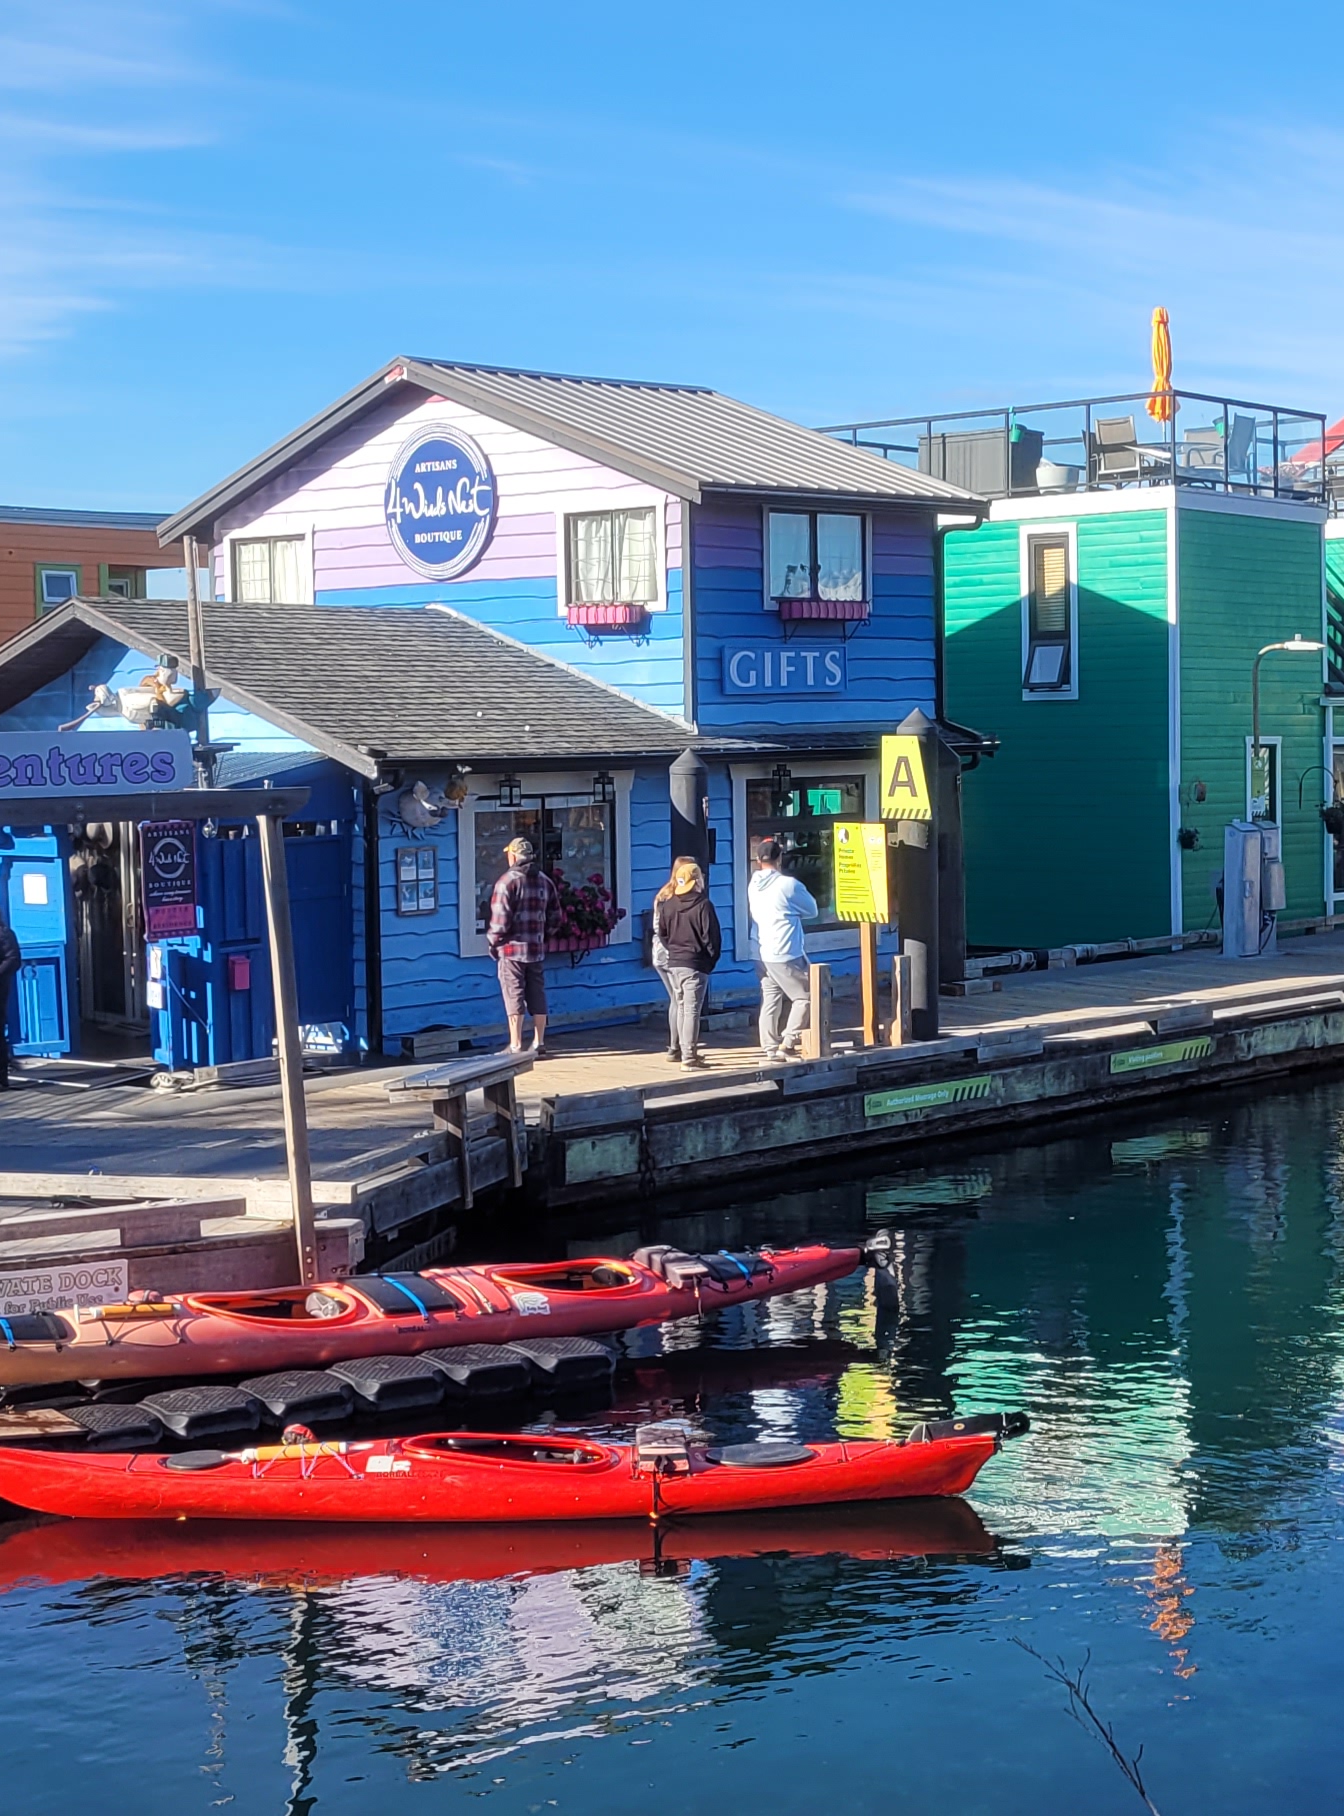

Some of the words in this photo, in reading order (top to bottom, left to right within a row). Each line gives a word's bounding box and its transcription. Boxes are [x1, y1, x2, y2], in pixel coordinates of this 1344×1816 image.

[414, 459, 458, 473] ARTISANS
[387, 477, 404, 524] 4
[447, 476, 492, 517] Nest
[414, 530, 463, 544] BOUTIQUE
[729, 650, 842, 688] GIFTS
[887, 755, 919, 797] A
[147, 829, 190, 838] ARTISANS
[148, 880, 192, 889] BOUTIQUE
[58, 1266, 123, 1292] DOCK
[3, 1301, 27, 1315] for
[29, 1296, 74, 1313] Public
[76, 1293, 104, 1306] Use
